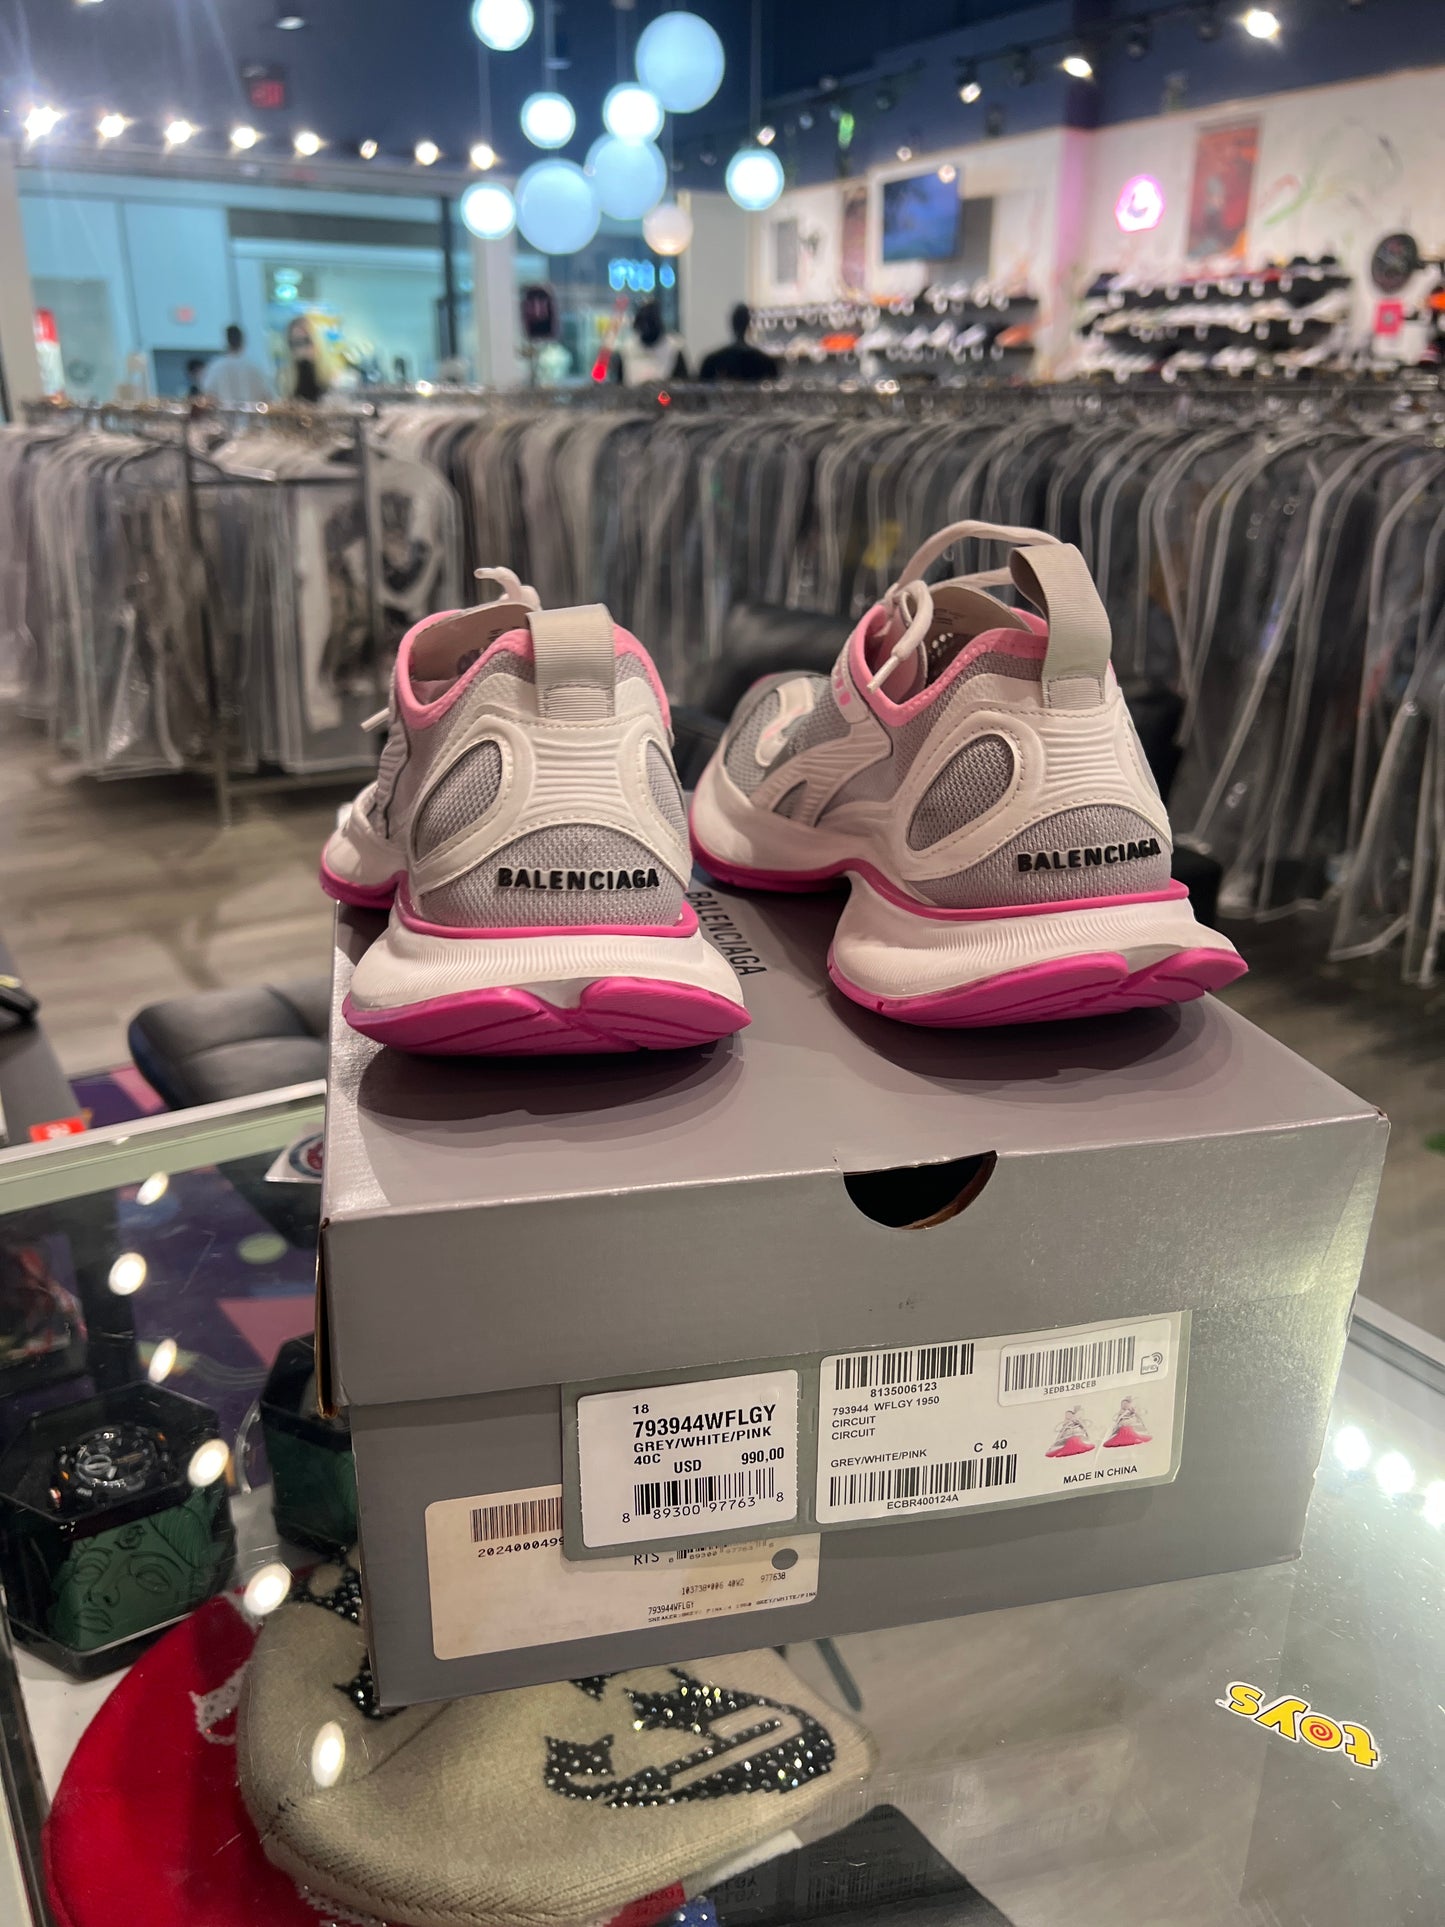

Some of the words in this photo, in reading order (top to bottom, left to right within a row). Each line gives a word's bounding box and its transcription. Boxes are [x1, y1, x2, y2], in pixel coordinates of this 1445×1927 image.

[1017, 838, 1161, 873] BALENCIAGA
[498, 867, 659, 890] BALENCIAGA
[684, 891, 768, 976] BALENCIAGA
[870, 1381, 938, 1398] 8135006123
[632, 1404, 650, 1415] 18
[832, 1405, 869, 1416] 793944
[874, 1399, 913, 1411] WFLGY
[916, 1396, 940, 1407] 1950
[632, 1404, 777, 1438] 793944WFLGY
[831, 1415, 877, 1428] CIRCUIT
[633, 1426, 772, 1453] GREY/WHITE/PINK
[831, 1428, 876, 1440] CIRCUIT
[973, 1442, 984, 1453] C
[992, 1439, 1008, 1451] 40
[633, 1453, 661, 1466] 40C
[673, 1459, 702, 1474] USD
[830, 1449, 927, 1468] GREY/WHITE/PINK
[1063, 1471, 1092, 1484] MADE
[1094, 1470, 1105, 1479] IN
[1106, 1465, 1138, 1476] CHINA
[622, 1513, 631, 1523] 8
[653, 1504, 701, 1519] 89300
[709, 1497, 756, 1512] 97763
[776, 1492, 784, 1502] 8
[887, 1494, 959, 1510] ECBR400124A
[1229, 1684, 1379, 1767] toys
